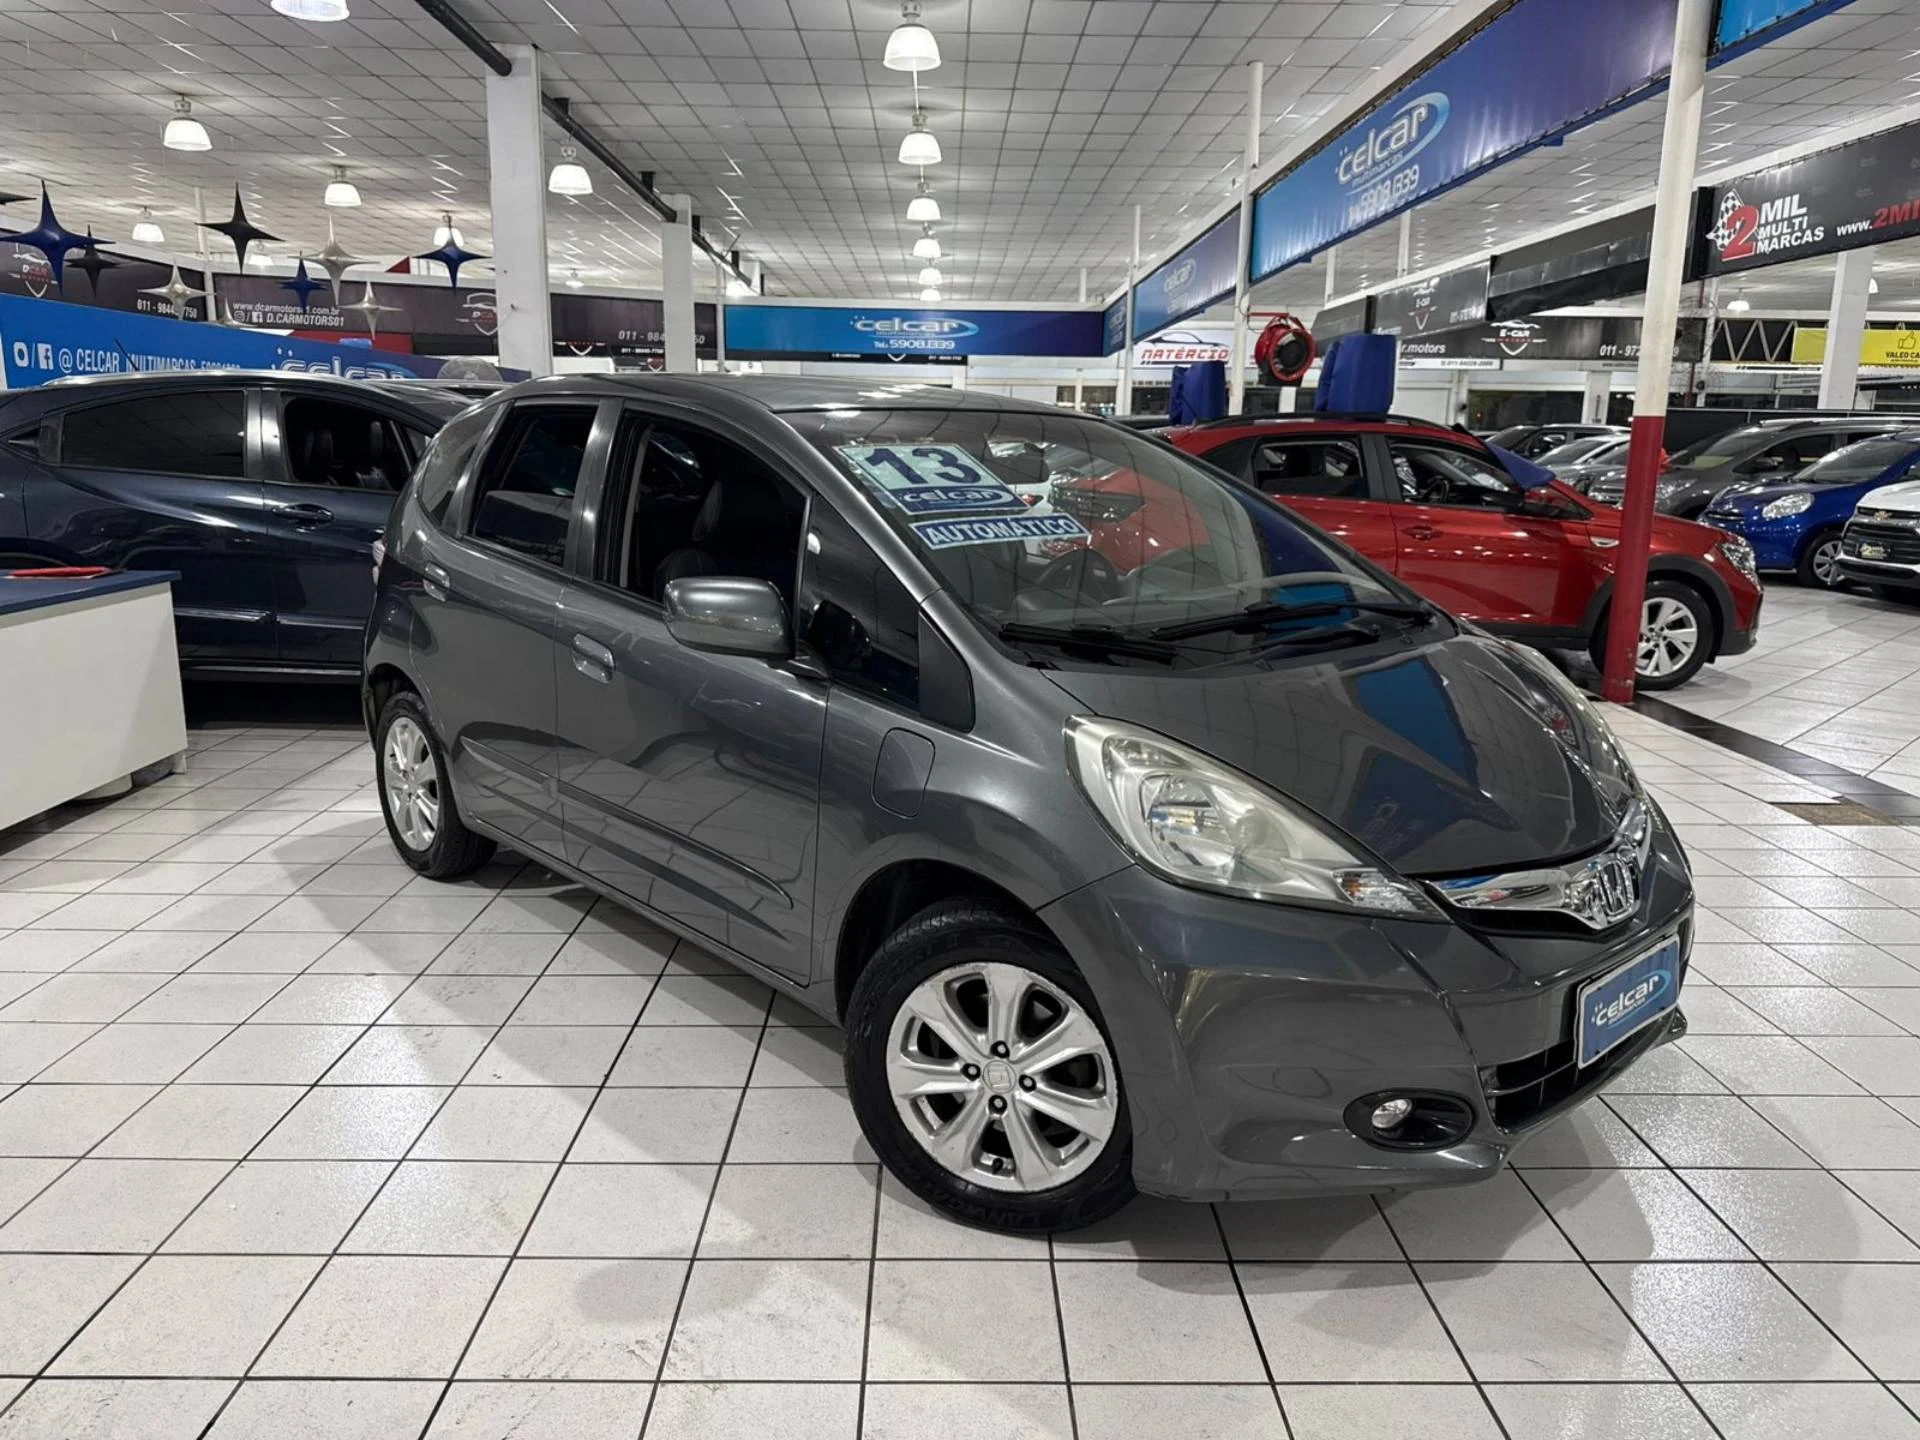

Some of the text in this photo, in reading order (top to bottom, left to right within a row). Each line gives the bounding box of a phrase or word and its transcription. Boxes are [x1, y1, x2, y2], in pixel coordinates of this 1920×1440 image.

[1338, 102, 1428, 184] celcar
[1760, 194, 1808, 224] MIL
[1755, 226, 1825, 255] MARCAS
[1757, 215, 1808, 241] MULTI
[266, 312, 345, 327] D.CARMOTORS01
[855, 317, 958, 332] celcar
[618, 330, 637, 341] 011
[1500, 329, 1530, 337] E-CAR
[76, 349, 120, 373] CELCAR
[1600, 344, 1617, 357] 011
[866, 448, 981, 484] 13
[903, 489, 995, 502] celcar
[926, 517, 1079, 543] AUTOMÁTICO
[1596, 975, 1659, 1026] celcar
